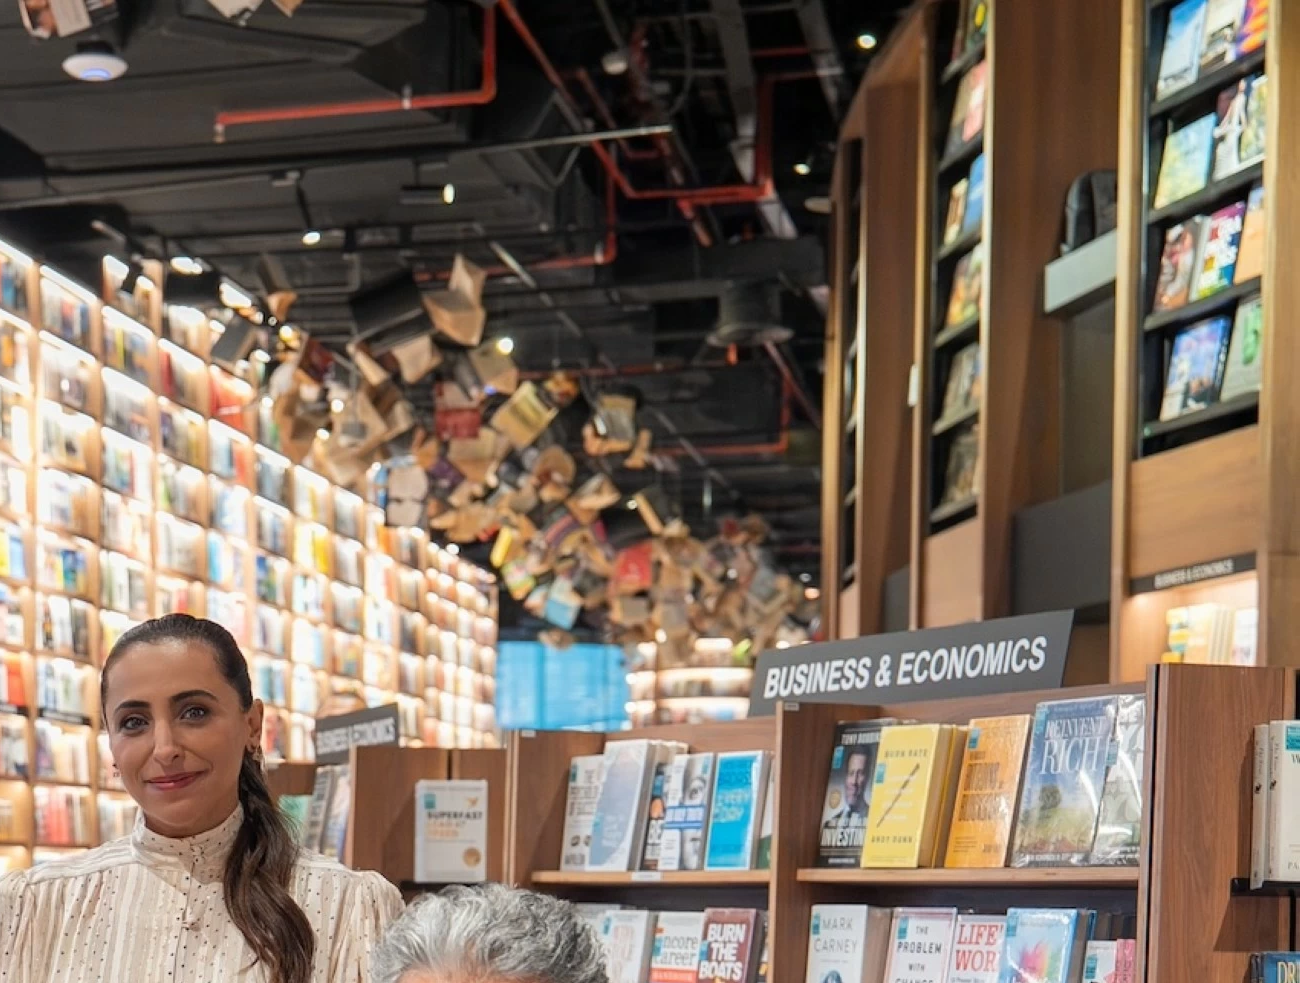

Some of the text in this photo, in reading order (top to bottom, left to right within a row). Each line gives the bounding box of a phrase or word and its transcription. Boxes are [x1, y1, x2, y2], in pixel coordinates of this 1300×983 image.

[763, 635, 1048, 699] BUSINESS & ECONOMICS
[908, 749, 928, 757] RATE
[1039, 737, 1102, 775] RICH
[427, 811, 483, 819] SUPERFAST
[822, 917, 853, 931] MARK
[915, 926, 929, 935] THE
[707, 923, 746, 943] BURN
[660, 935, 699, 950] ncore
[813, 938, 858, 953] CARNEY
[897, 941, 942, 954] PROBLEM
[710, 942, 737, 961] THE
[699, 961, 743, 981] BOATS
[908, 963, 925, 972] WITH
